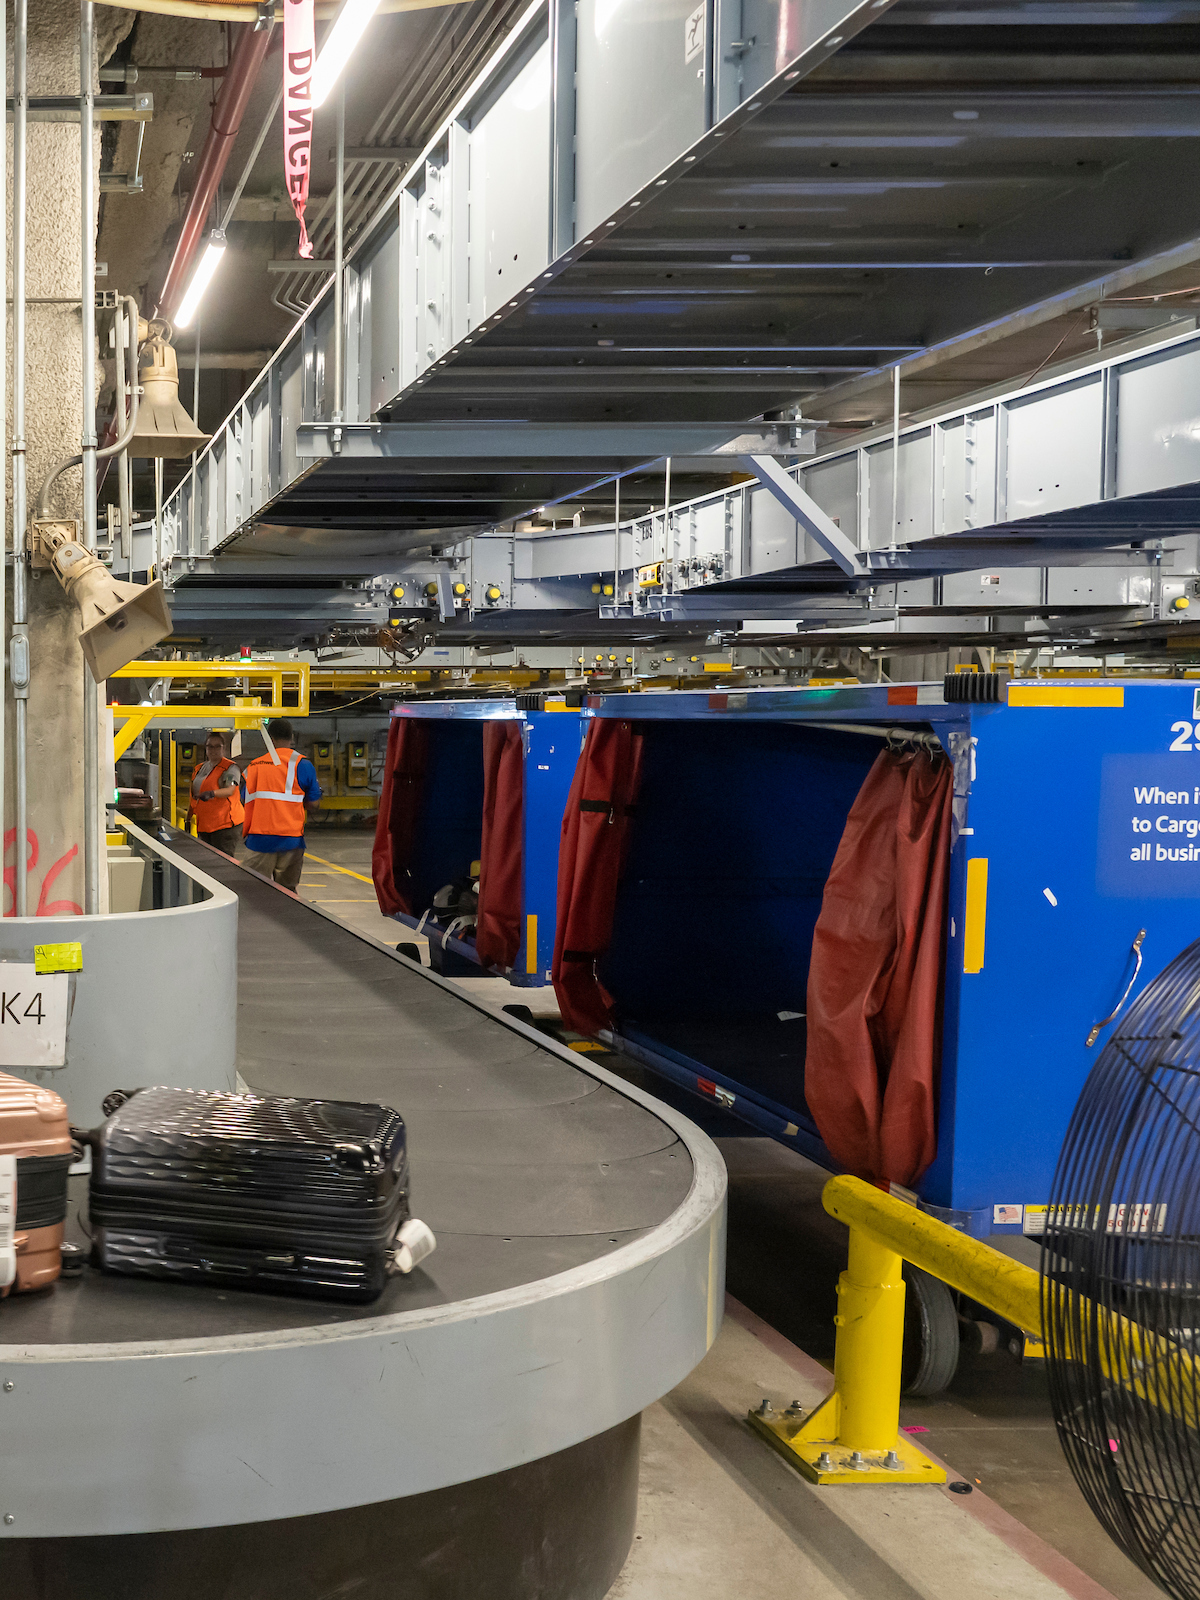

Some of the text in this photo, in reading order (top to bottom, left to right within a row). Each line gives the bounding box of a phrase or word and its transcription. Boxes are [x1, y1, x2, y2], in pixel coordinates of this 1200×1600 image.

[1169, 720, 1200, 751] 2
[1133, 786, 1200, 804] When i
[1132, 815, 1200, 838] to Carg
[1130, 843, 1151, 861] all
